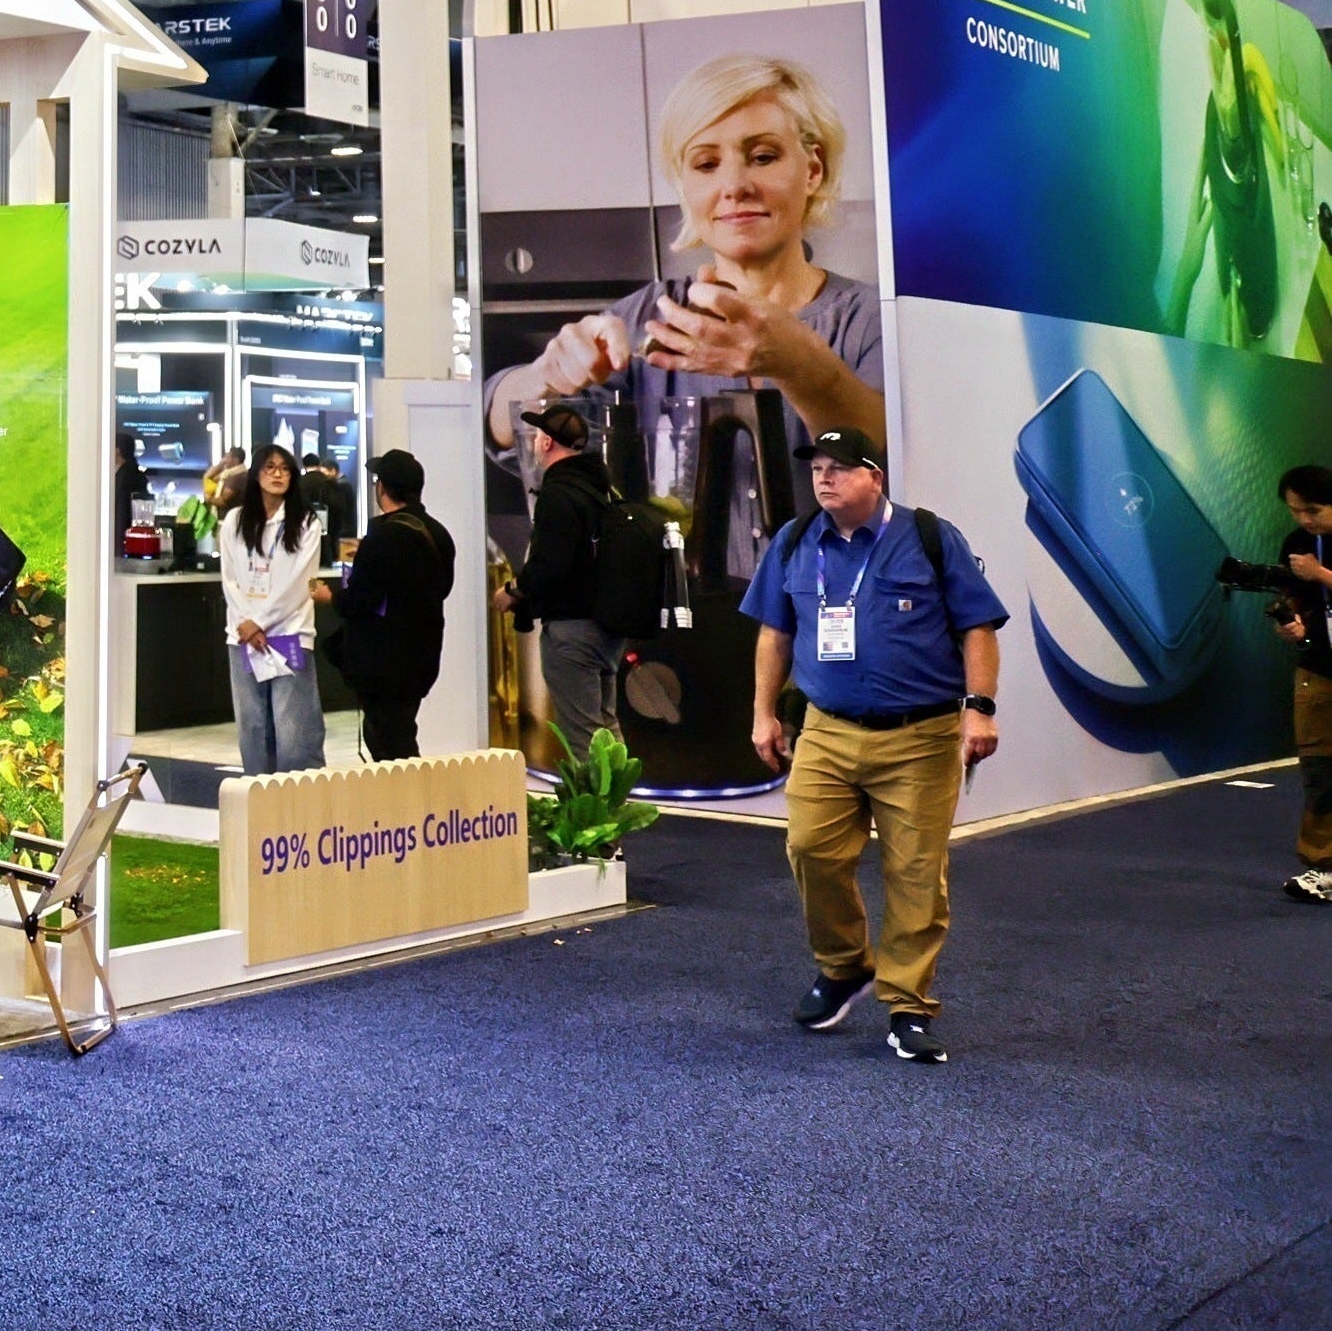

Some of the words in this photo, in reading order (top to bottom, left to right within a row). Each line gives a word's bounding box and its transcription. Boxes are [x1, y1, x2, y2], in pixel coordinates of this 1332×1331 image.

[966, 16, 1061, 72] CONSORTIUM
[312, 62, 335, 80] Smart
[337, 68, 360, 87] Home
[145, 238, 222, 255] COZYLA
[314, 249, 351, 269] COZYLA
[261, 832, 311, 876] 99%
[317, 820, 417, 872] Clippings
[422, 804, 518, 849] Collection
